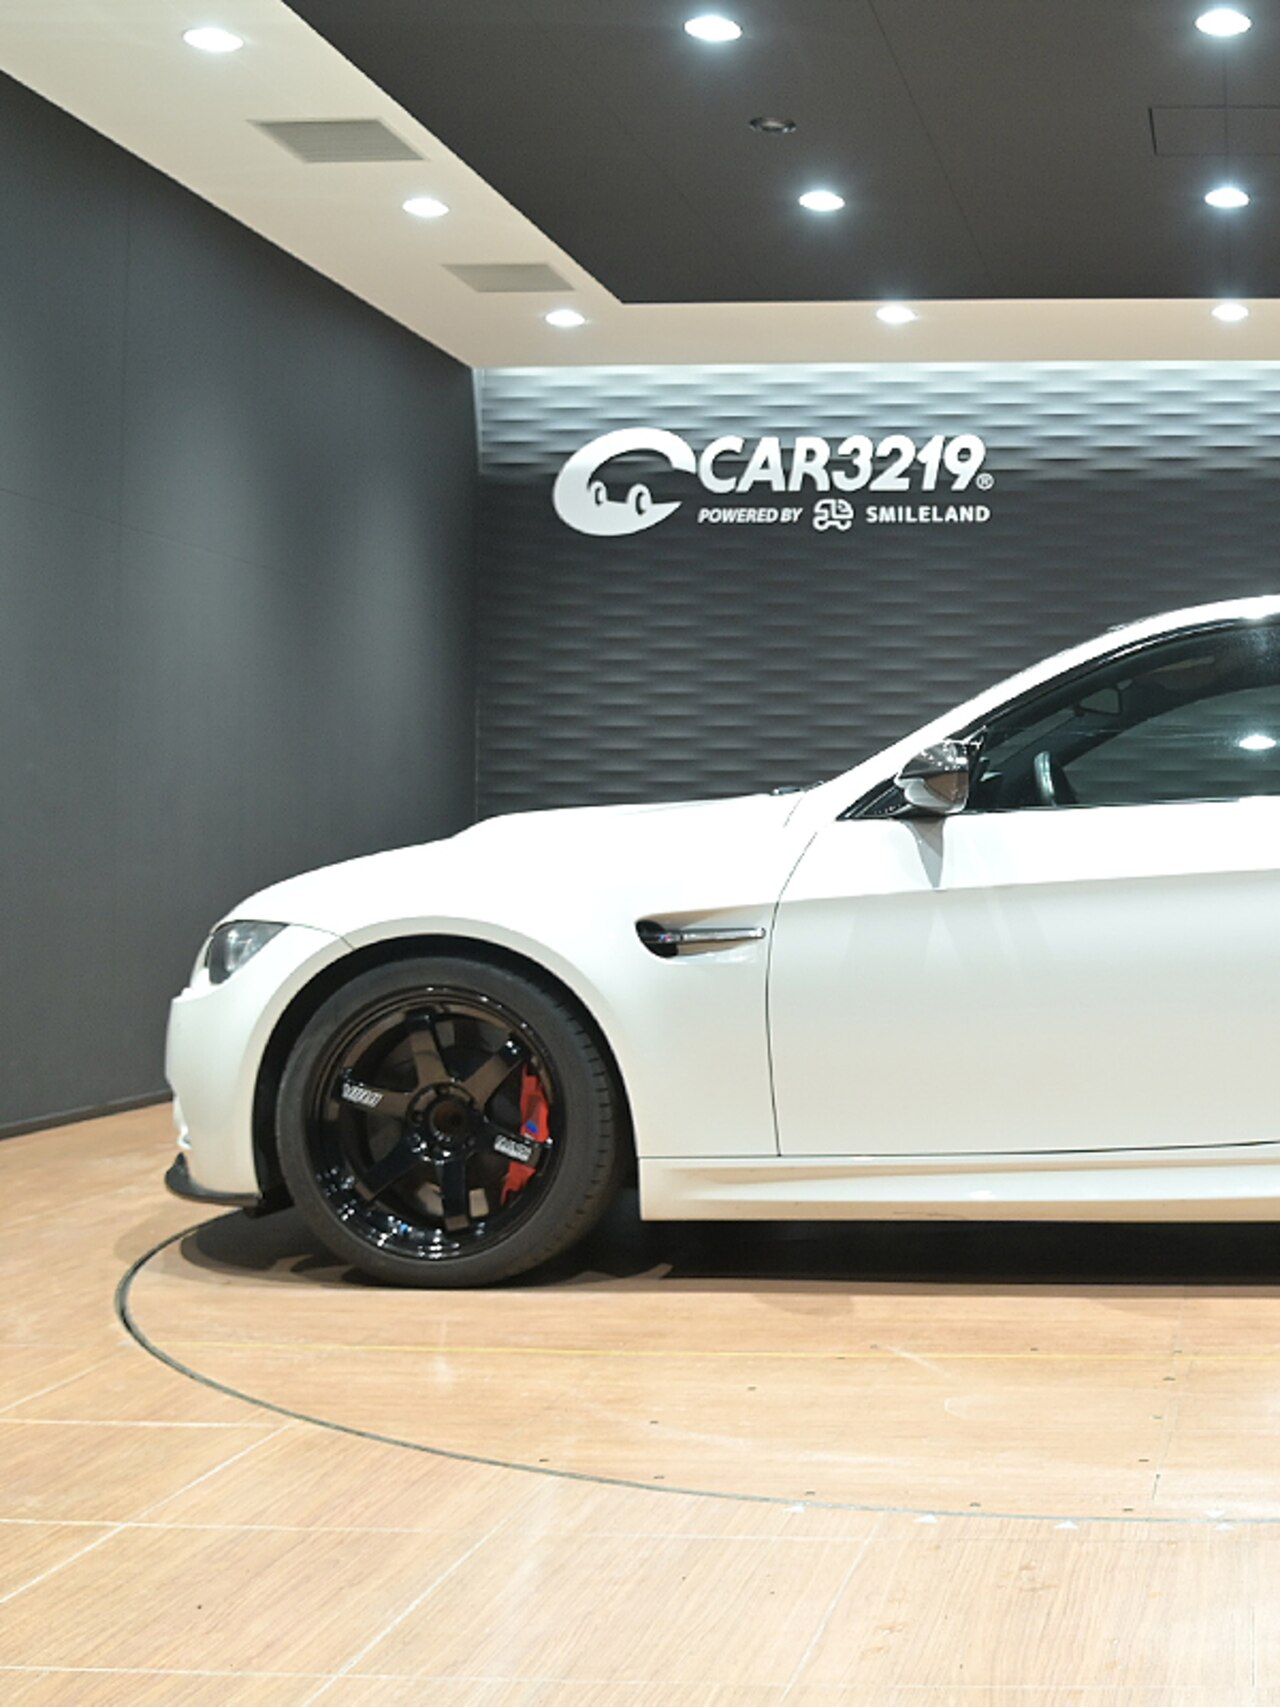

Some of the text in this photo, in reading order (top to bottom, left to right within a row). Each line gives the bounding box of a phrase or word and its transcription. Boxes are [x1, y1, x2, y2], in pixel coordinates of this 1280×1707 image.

[698, 505, 991, 524] POWERED BY SMILELAND
